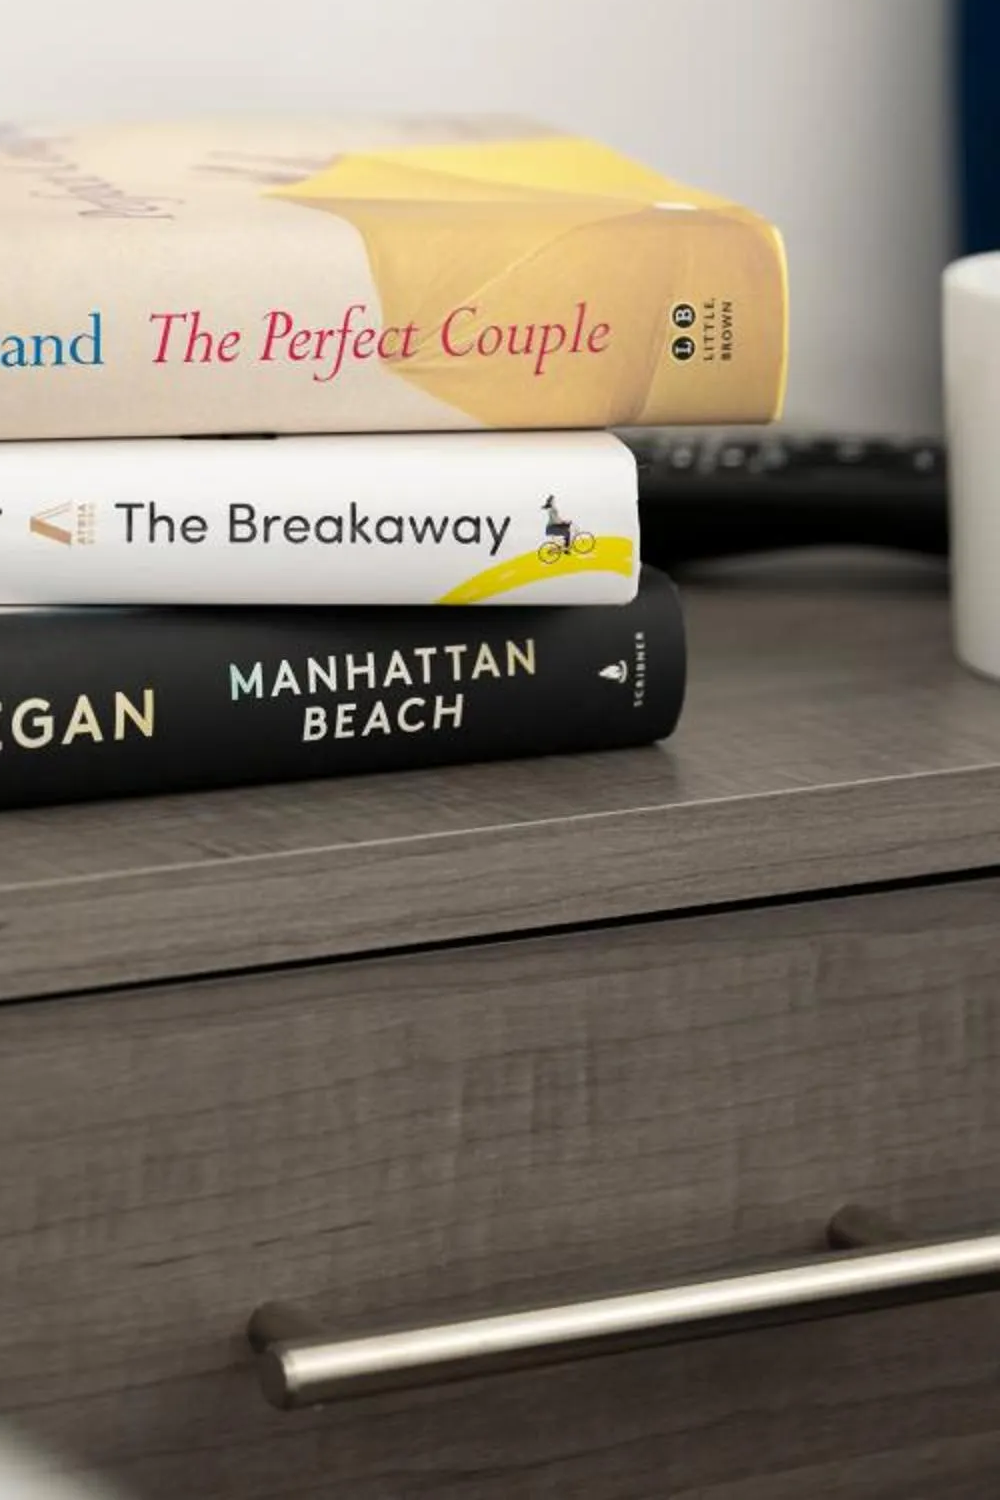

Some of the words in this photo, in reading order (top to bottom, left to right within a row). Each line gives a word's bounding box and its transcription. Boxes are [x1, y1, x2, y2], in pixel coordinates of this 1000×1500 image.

[150, 311, 241, 365] The
[259, 304, 419, 383] Perfect
[440, 302, 612, 376] Couple
[720, 301, 733, 361] BROWN
[115, 501, 208, 543] The
[229, 501, 511, 556] Breakaway
[229, 638, 537, 701] MANHATTAN
[633, 631, 646, 708] SCRIBNER
[302, 693, 465, 742] BEACH
